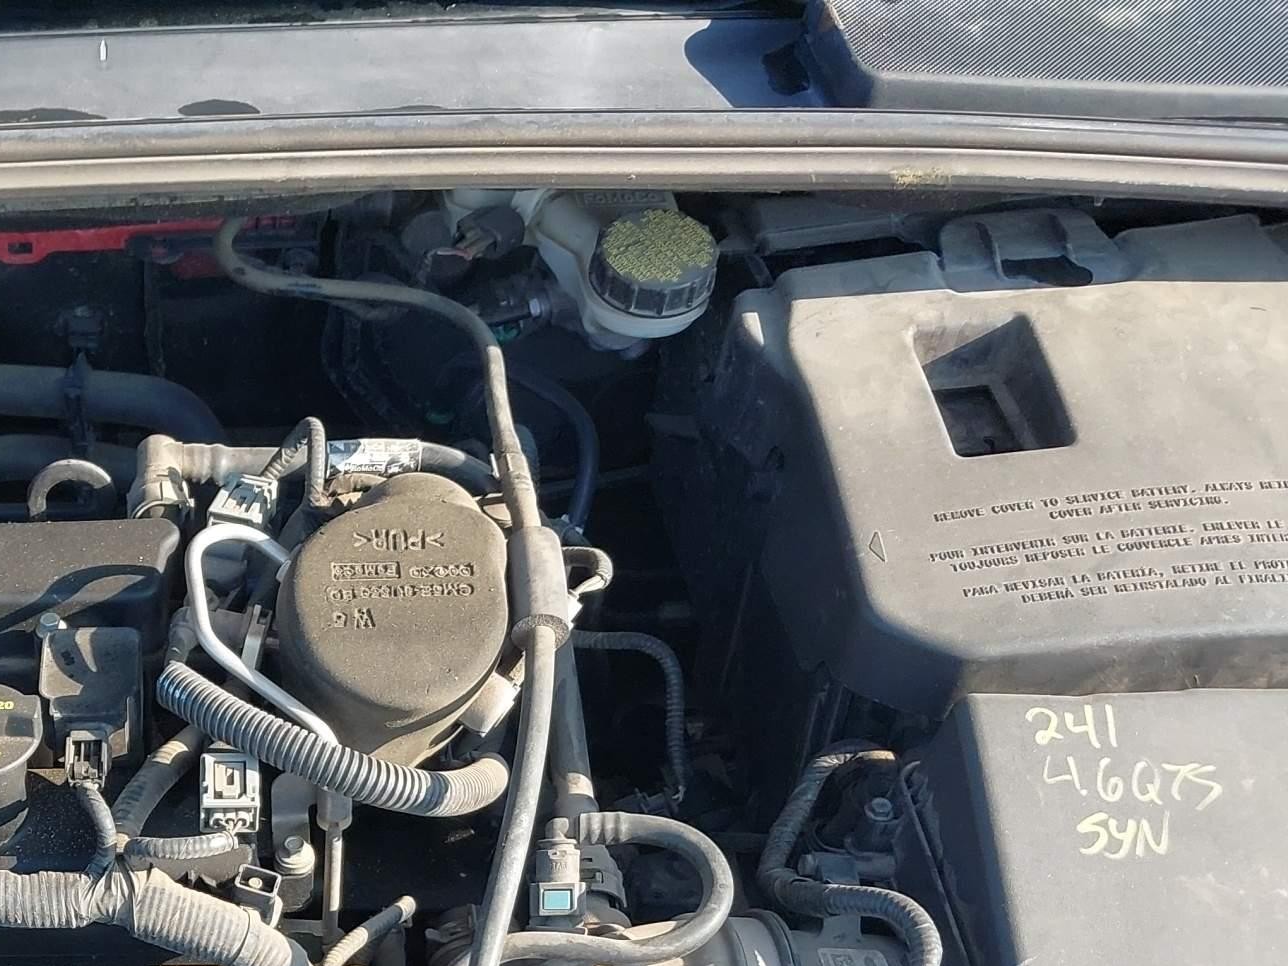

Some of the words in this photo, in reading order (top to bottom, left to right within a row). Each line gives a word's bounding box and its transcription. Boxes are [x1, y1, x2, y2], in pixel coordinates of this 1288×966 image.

[934, 507, 984, 523] REMOVE
[991, 500, 1035, 516] COVER
[1040, 496, 1058, 508] TO
[1065, 489, 1122, 507] SERVICE
[1204, 480, 1253, 493] ALWAYS
[1049, 506, 1093, 520] COVER
[1099, 501, 1142, 516] AFTER
[1148, 495, 1230, 511] SERVICING.
[929, 546, 965, 563] POUR
[971, 537, 1056, 557] INTERVENIR
[1062, 532, 1089, 545] SUR
[1096, 530, 1115, 542] LA
[1202, 520, 1260, 533] ENLEVER
[1267, 519, 1285, 530] LE
[950, 555, 1018, 573] TOUJOURS
[1025, 549, 1087, 564] REPOSER
[1093, 544, 1111, 556] LE
[1117, 537, 1192, 553] COUVERCLE
[962, 583, 999, 598] PARA
[1004, 576, 1067, 592] REVISAR
[1071, 573, 1092, 585] LA
[1172, 563, 1224, 576] RETIRE
[1230, 561, 1247, 571] EL
[1080, 584, 1108, 597] SER
[1114, 576, 1207, 594] REINSTALADO
[1215, 575, 1232, 586] AL
[1025, 703, 1118, 749] 241
[1076, 810, 1171, 860] SYN
